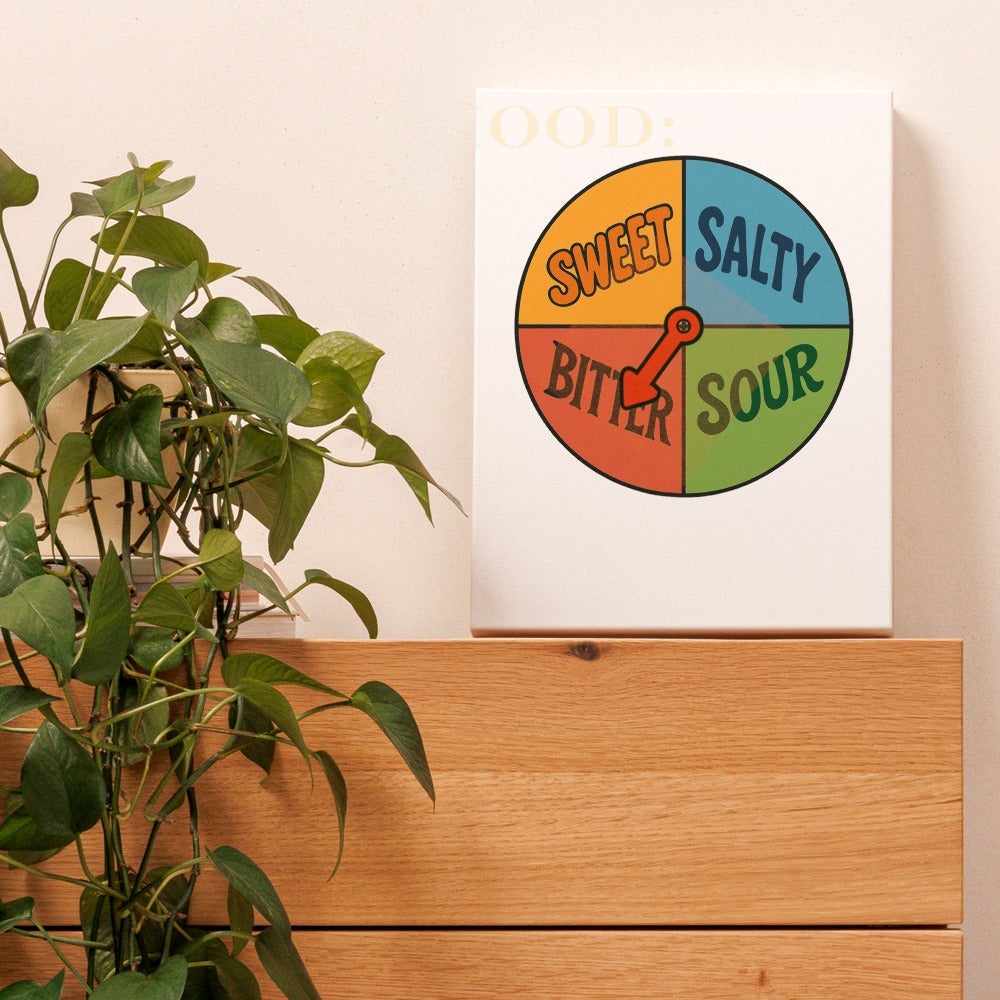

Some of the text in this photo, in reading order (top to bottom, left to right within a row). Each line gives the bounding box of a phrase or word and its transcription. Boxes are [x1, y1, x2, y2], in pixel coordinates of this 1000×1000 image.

[475, 104, 675, 149] OOD:
[546, 203, 674, 308] SWEET
[694, 205, 822, 304] SALTY
[696, 343, 825, 436] SOUR
